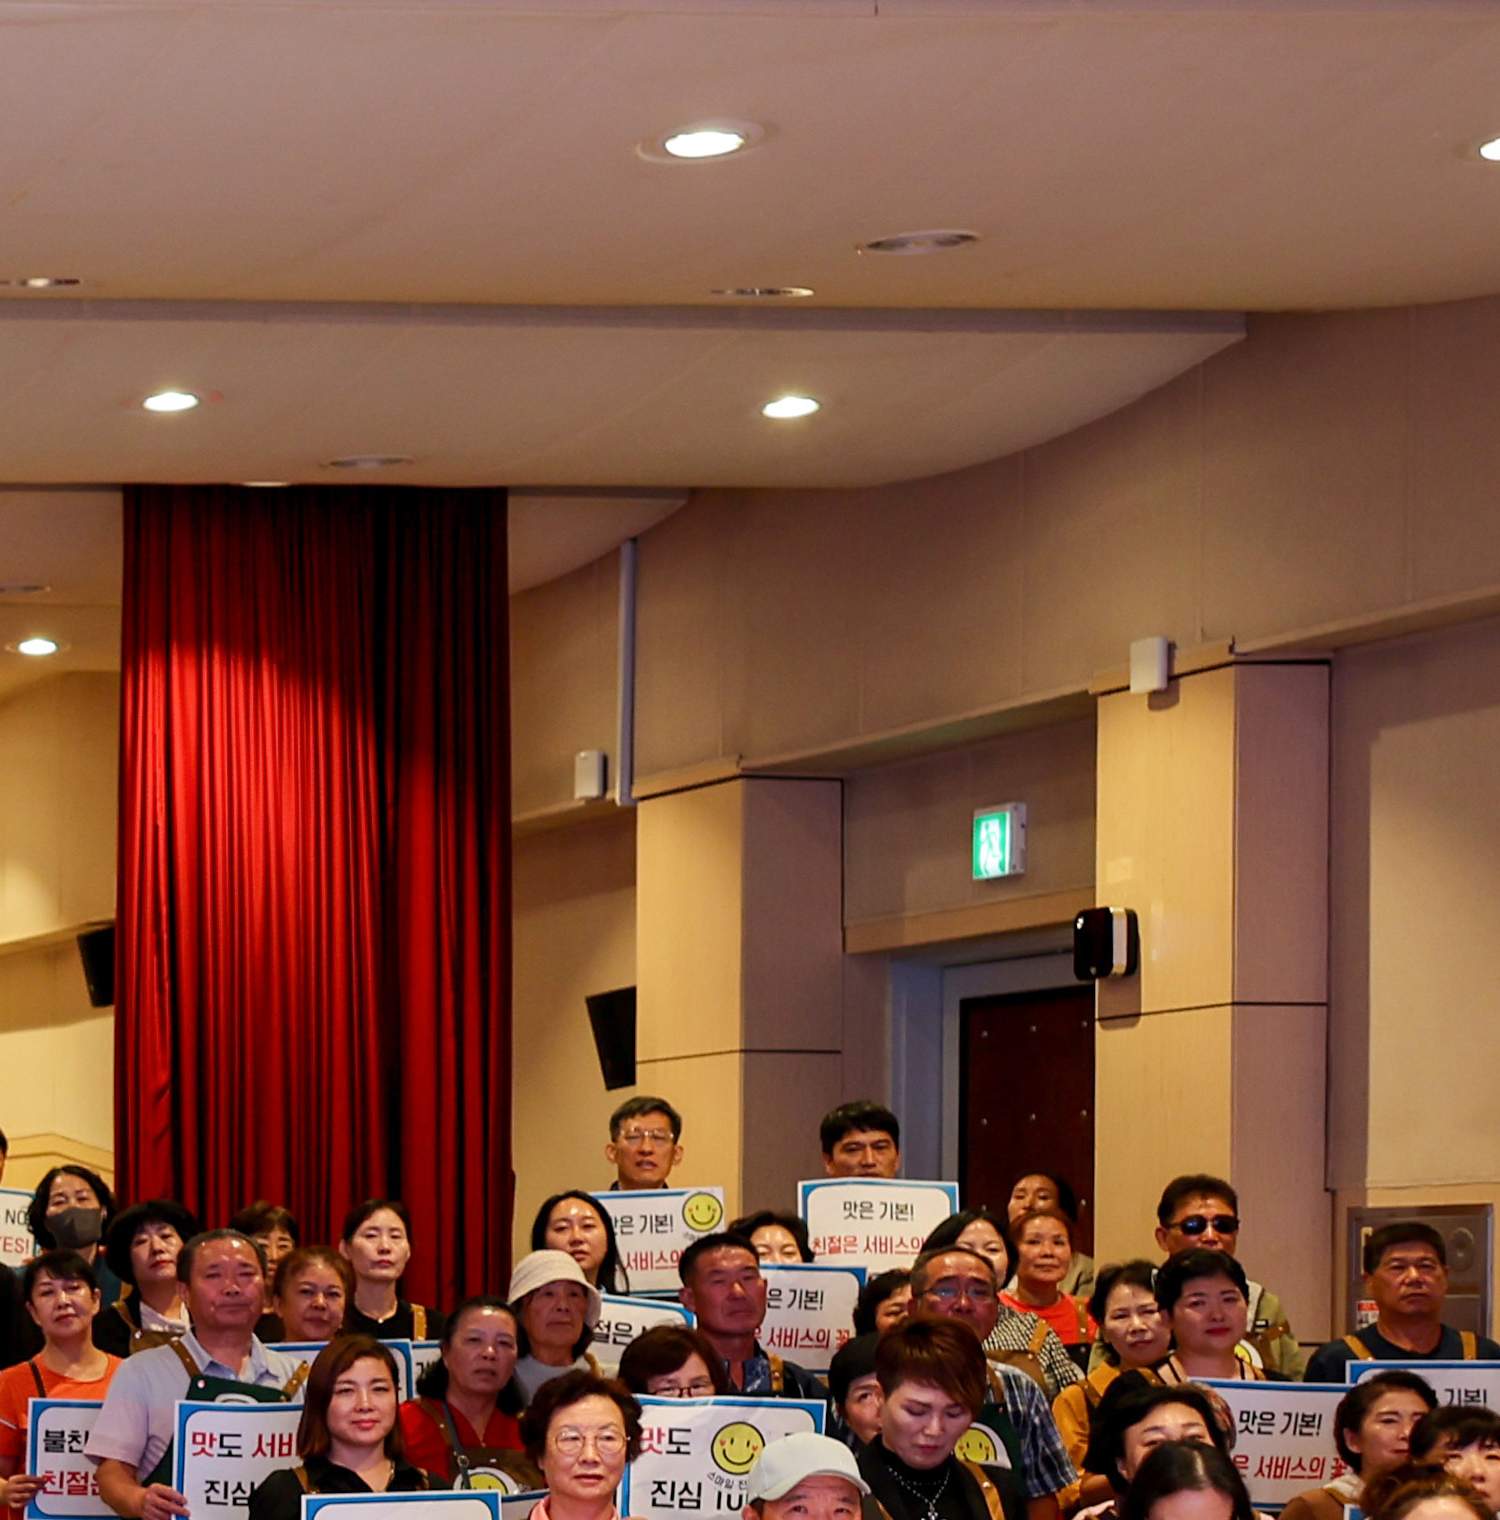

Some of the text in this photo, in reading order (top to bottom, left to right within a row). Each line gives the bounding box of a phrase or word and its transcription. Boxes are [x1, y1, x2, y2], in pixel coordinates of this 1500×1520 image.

[843, 1201, 913, 1221] 맛은 기본!
[640, 1215, 673, 1234] 기본!
[812, 1235, 858, 1257] 친절은
[787, 1289, 823, 1310] 기본!
[767, 1328, 830, 1350] 서비스의
[1239, 1410, 1322, 1436] 맛은 기본!
[192, 1432, 243, 1458] 맛도
[642, 1426, 692, 1456] 맛도
[1254, 1456, 1326, 1480] 서비스의
[651, 1481, 701, 1509] 진심
